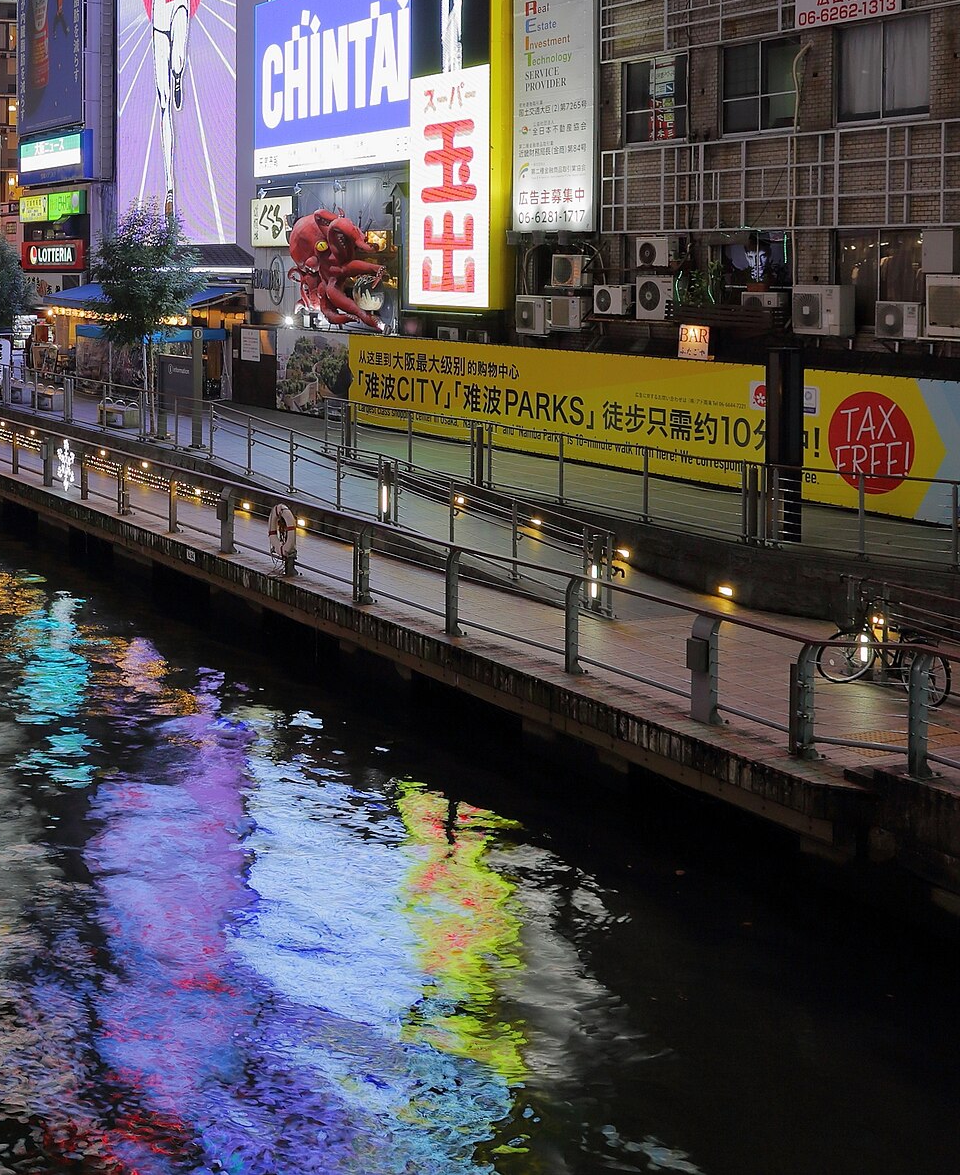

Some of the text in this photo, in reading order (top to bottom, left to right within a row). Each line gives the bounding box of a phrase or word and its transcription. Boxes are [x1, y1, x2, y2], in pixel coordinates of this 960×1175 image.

[525, 0, 550, 17] Real
[525, 18, 557, 34] Estate
[525, 34, 571, 51] Investment
[524, 51, 572, 66] Technology
[525, 66, 560, 80] SERVICE
[525, 77, 567, 92] PROVIDER
[518, 188, 586, 206] 広告主募集中
[421, 118, 477, 293] 玉出
[518, 209, 586, 225] 06-6281-1717
[38, 247, 73, 262] LOTTERIA
[680, 328, 708, 343] BAR
[841, 403, 897, 442] TAX
[835, 441, 910, 480] FREE!
